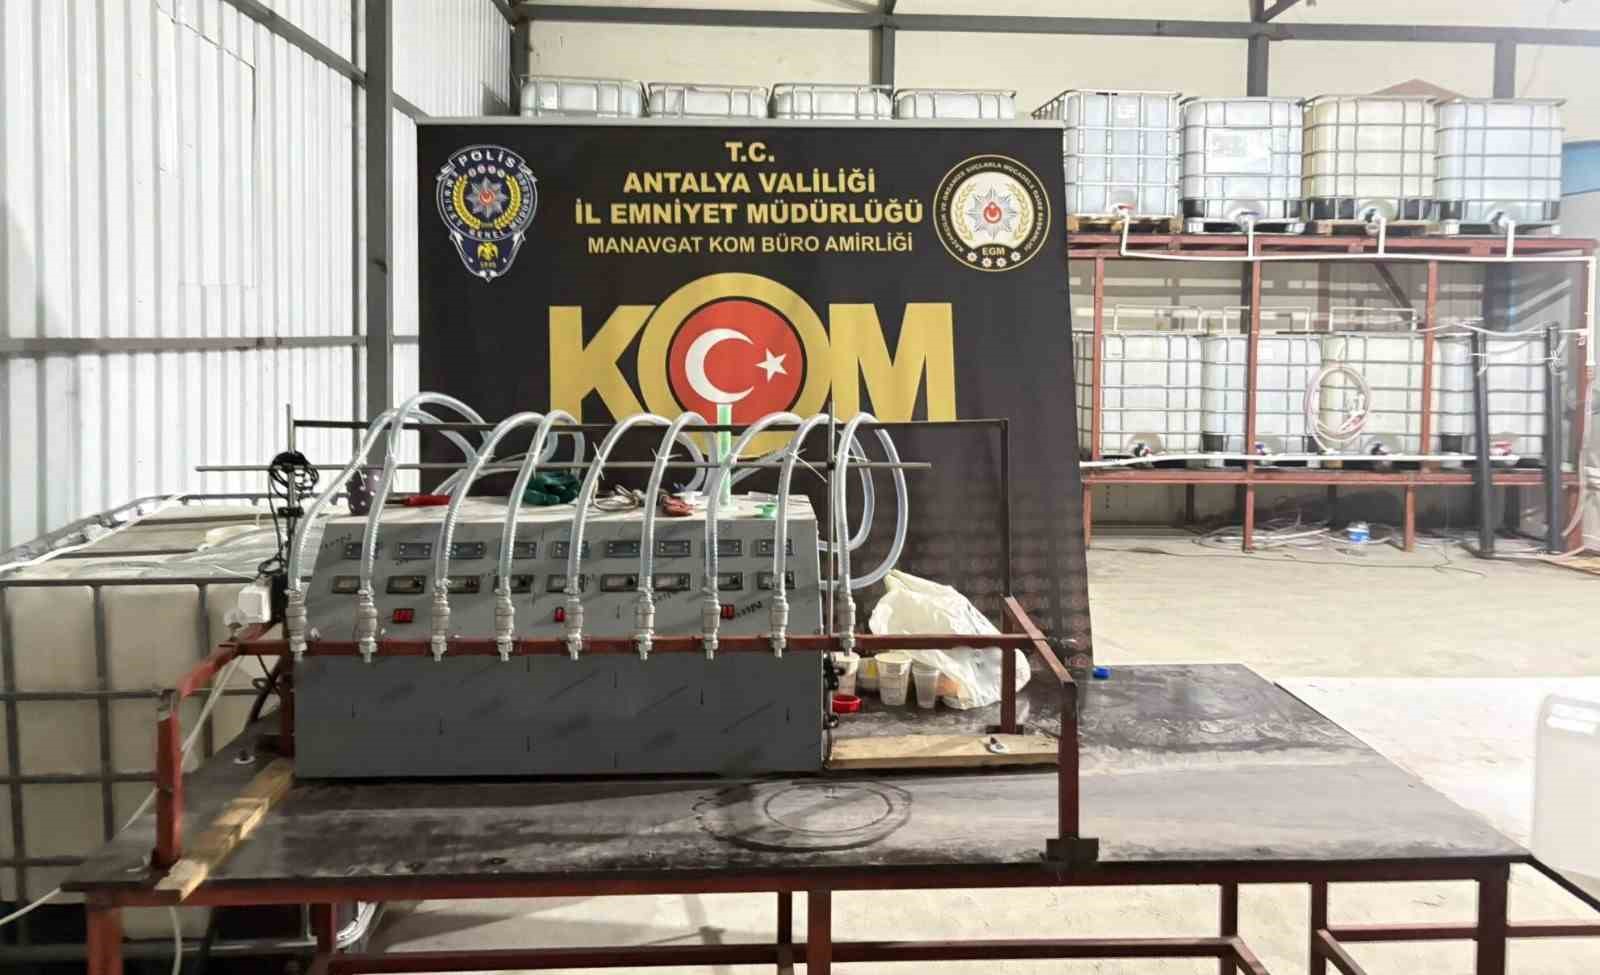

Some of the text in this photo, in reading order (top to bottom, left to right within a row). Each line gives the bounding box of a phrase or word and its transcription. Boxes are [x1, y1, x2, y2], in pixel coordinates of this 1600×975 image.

[458, 150, 516, 168] POLİS
[725, 141, 775, 162] T.C.
[623, 168, 876, 193] ANTALYA VALİLİĞİ
[575, 198, 923, 224] İL EMNİYET MÜDÜRLÜĞÜ
[588, 232, 912, 253] MANAVGAT KOM BÜRO AMİRLİĞİ
[982, 247, 1005, 256] EGM
[548, 272, 957, 458] KOM
